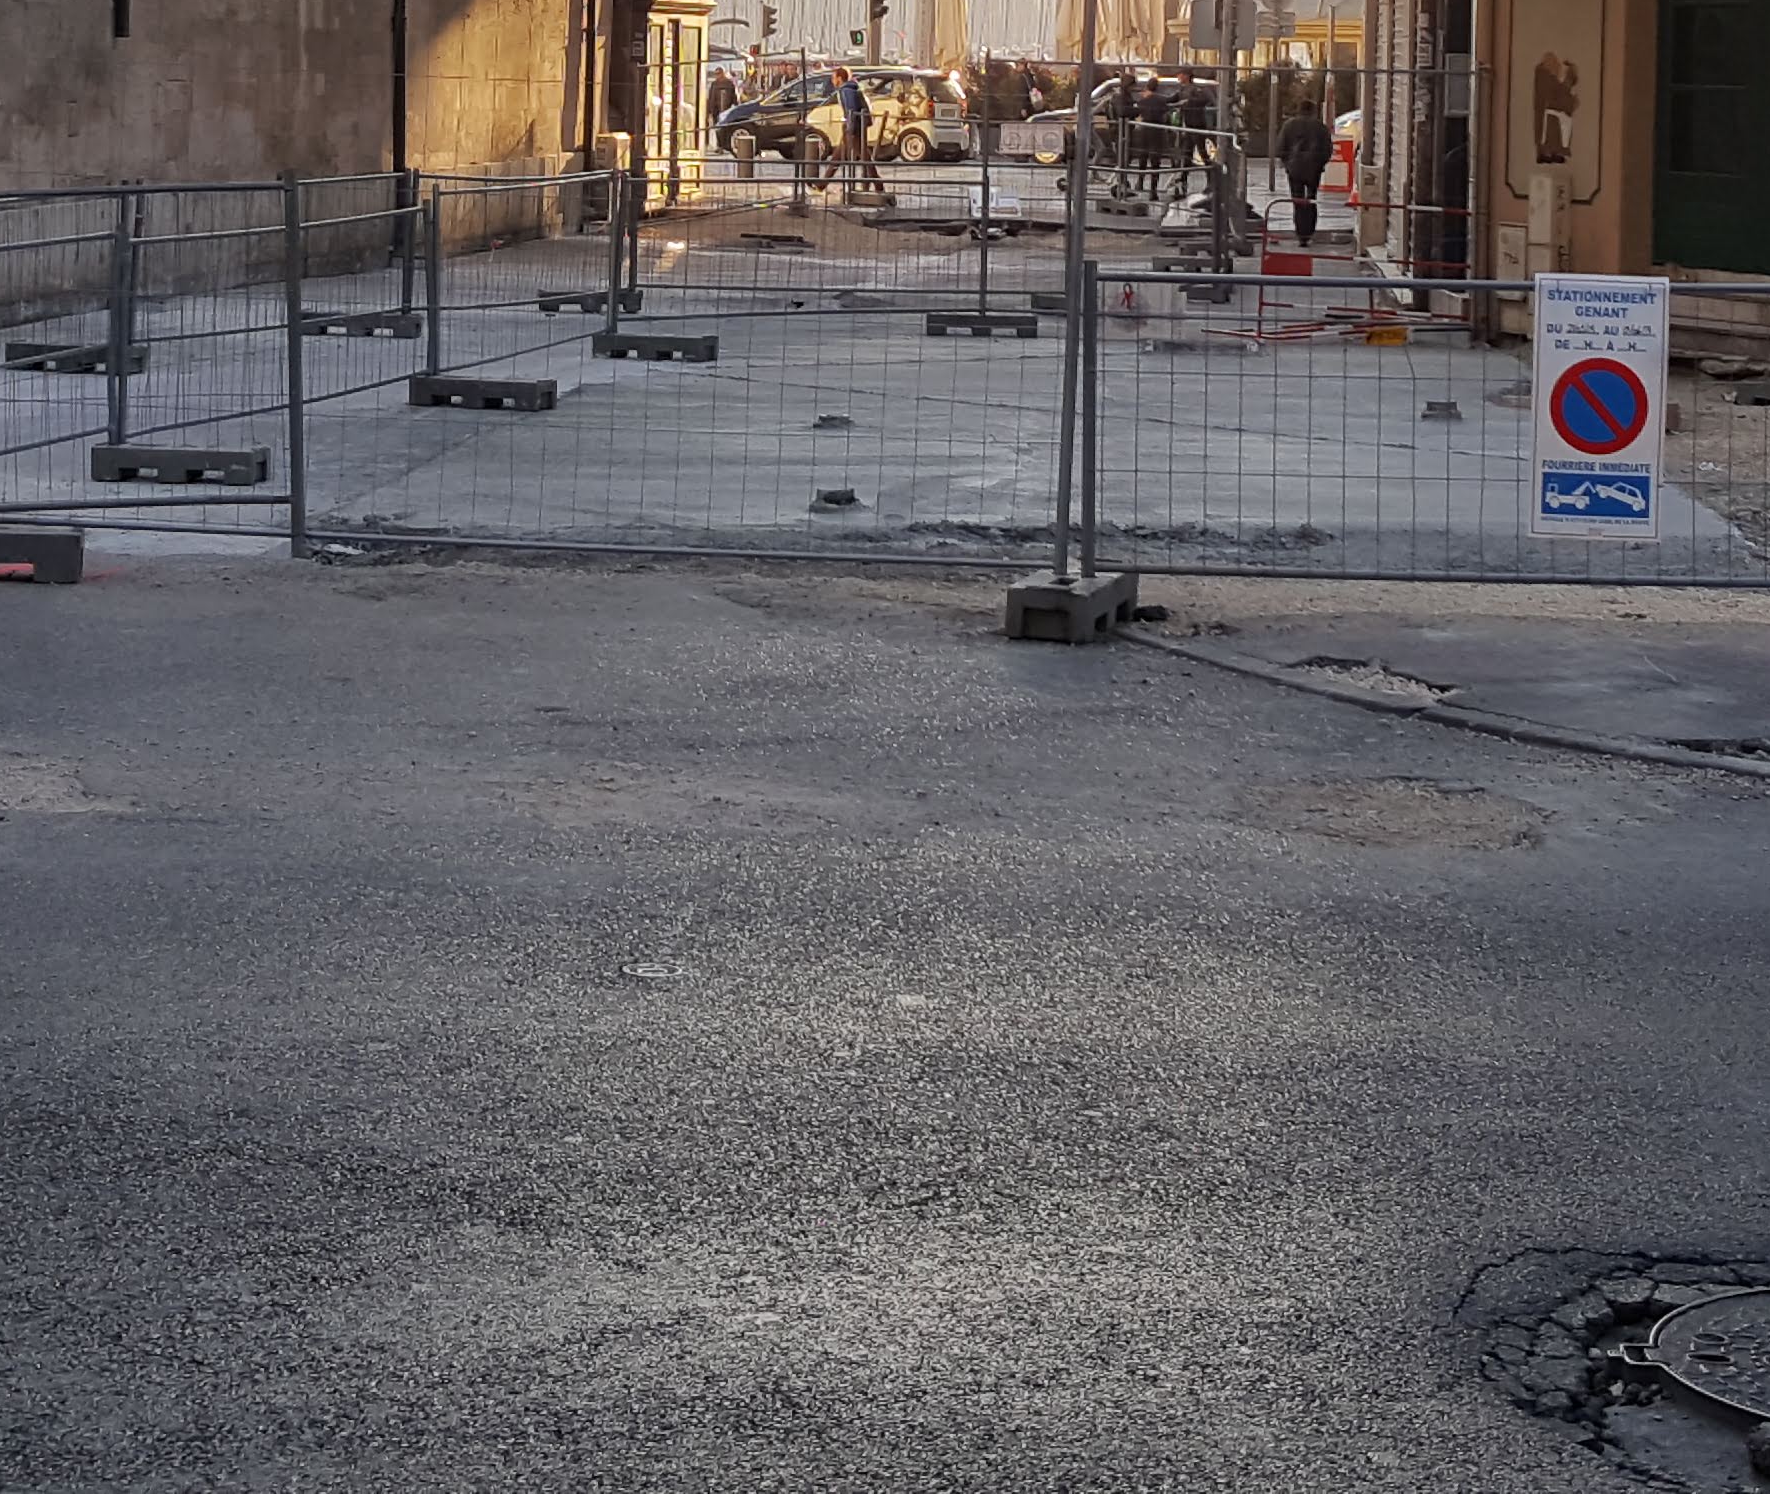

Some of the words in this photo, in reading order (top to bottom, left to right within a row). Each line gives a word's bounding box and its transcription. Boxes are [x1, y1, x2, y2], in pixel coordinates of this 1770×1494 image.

[1547, 289, 1657, 305] STATIONNEMENT
[1574, 305, 1629, 319] GENANT
[1546, 323, 1563, 334] DU
[1602, 324, 1620, 336] AU
[1554, 339, 1570, 350] DE
